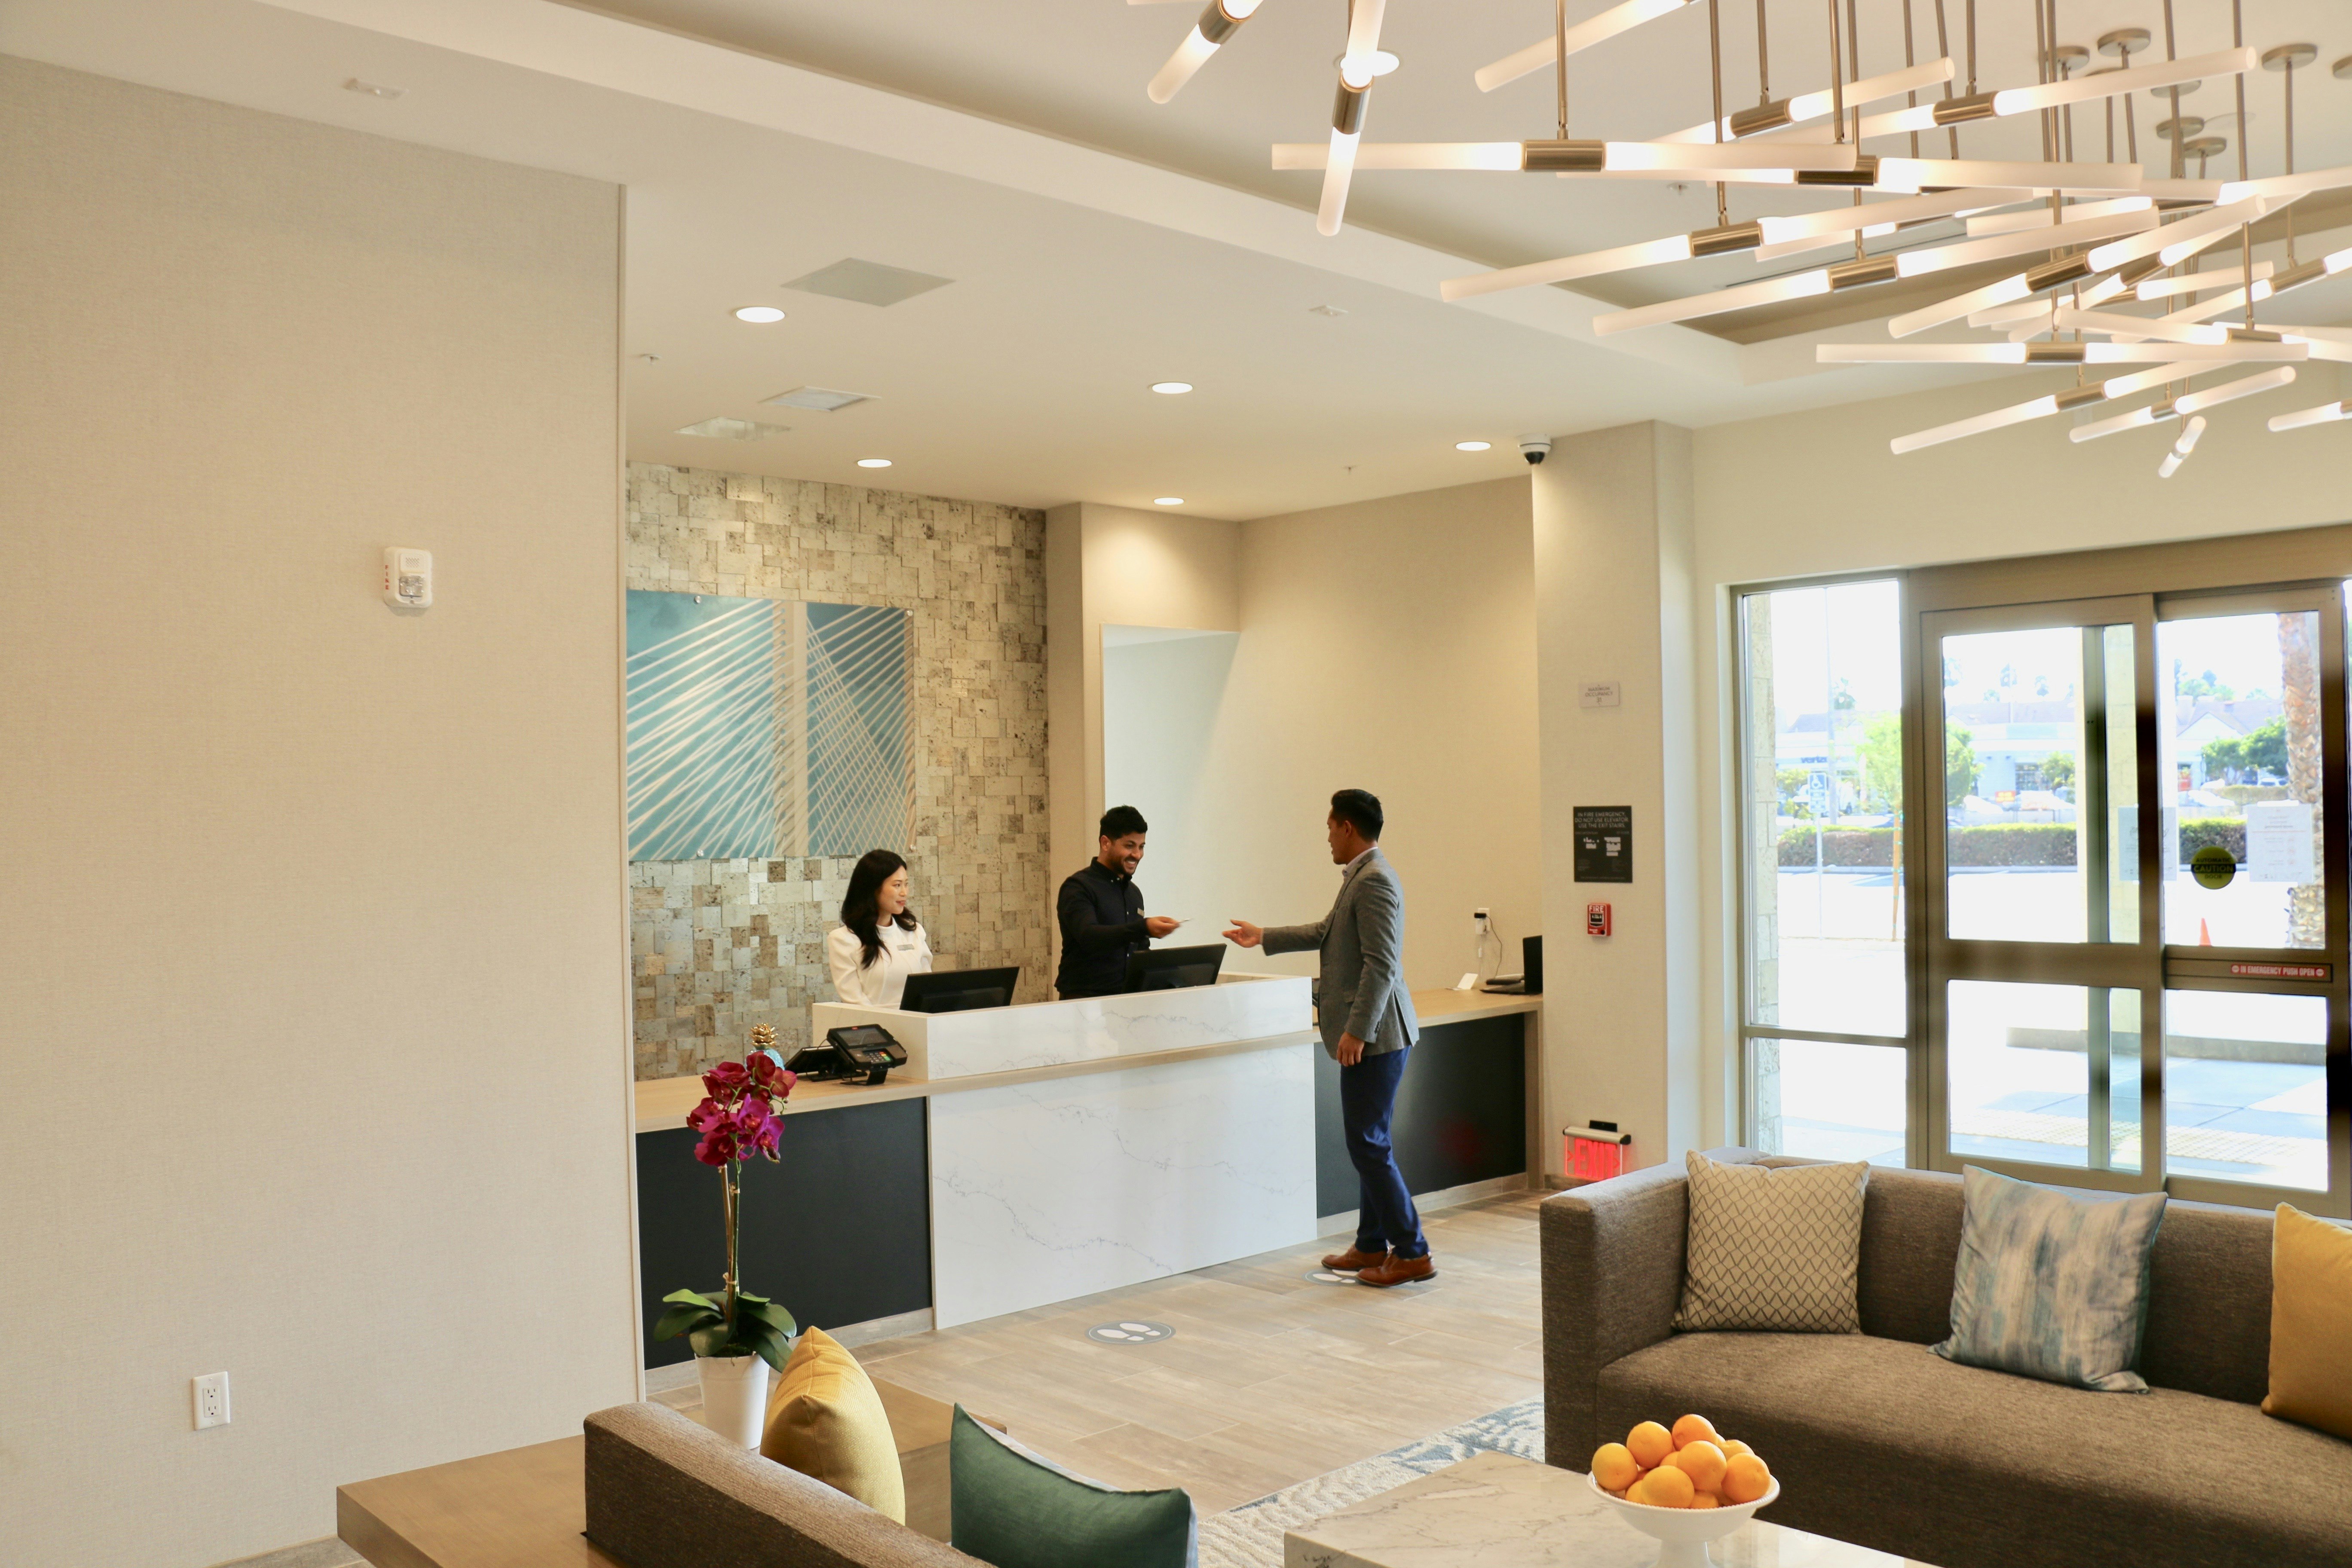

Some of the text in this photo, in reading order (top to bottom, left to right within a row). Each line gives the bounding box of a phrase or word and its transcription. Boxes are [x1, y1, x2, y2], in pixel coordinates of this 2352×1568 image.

[2248, 965, 2282, 974] EMERGENCY
[2283, 967, 2298, 975] PUSH
[2299, 968, 2315, 976] OPEN
[1575, 1138, 1617, 1179] EXIT
